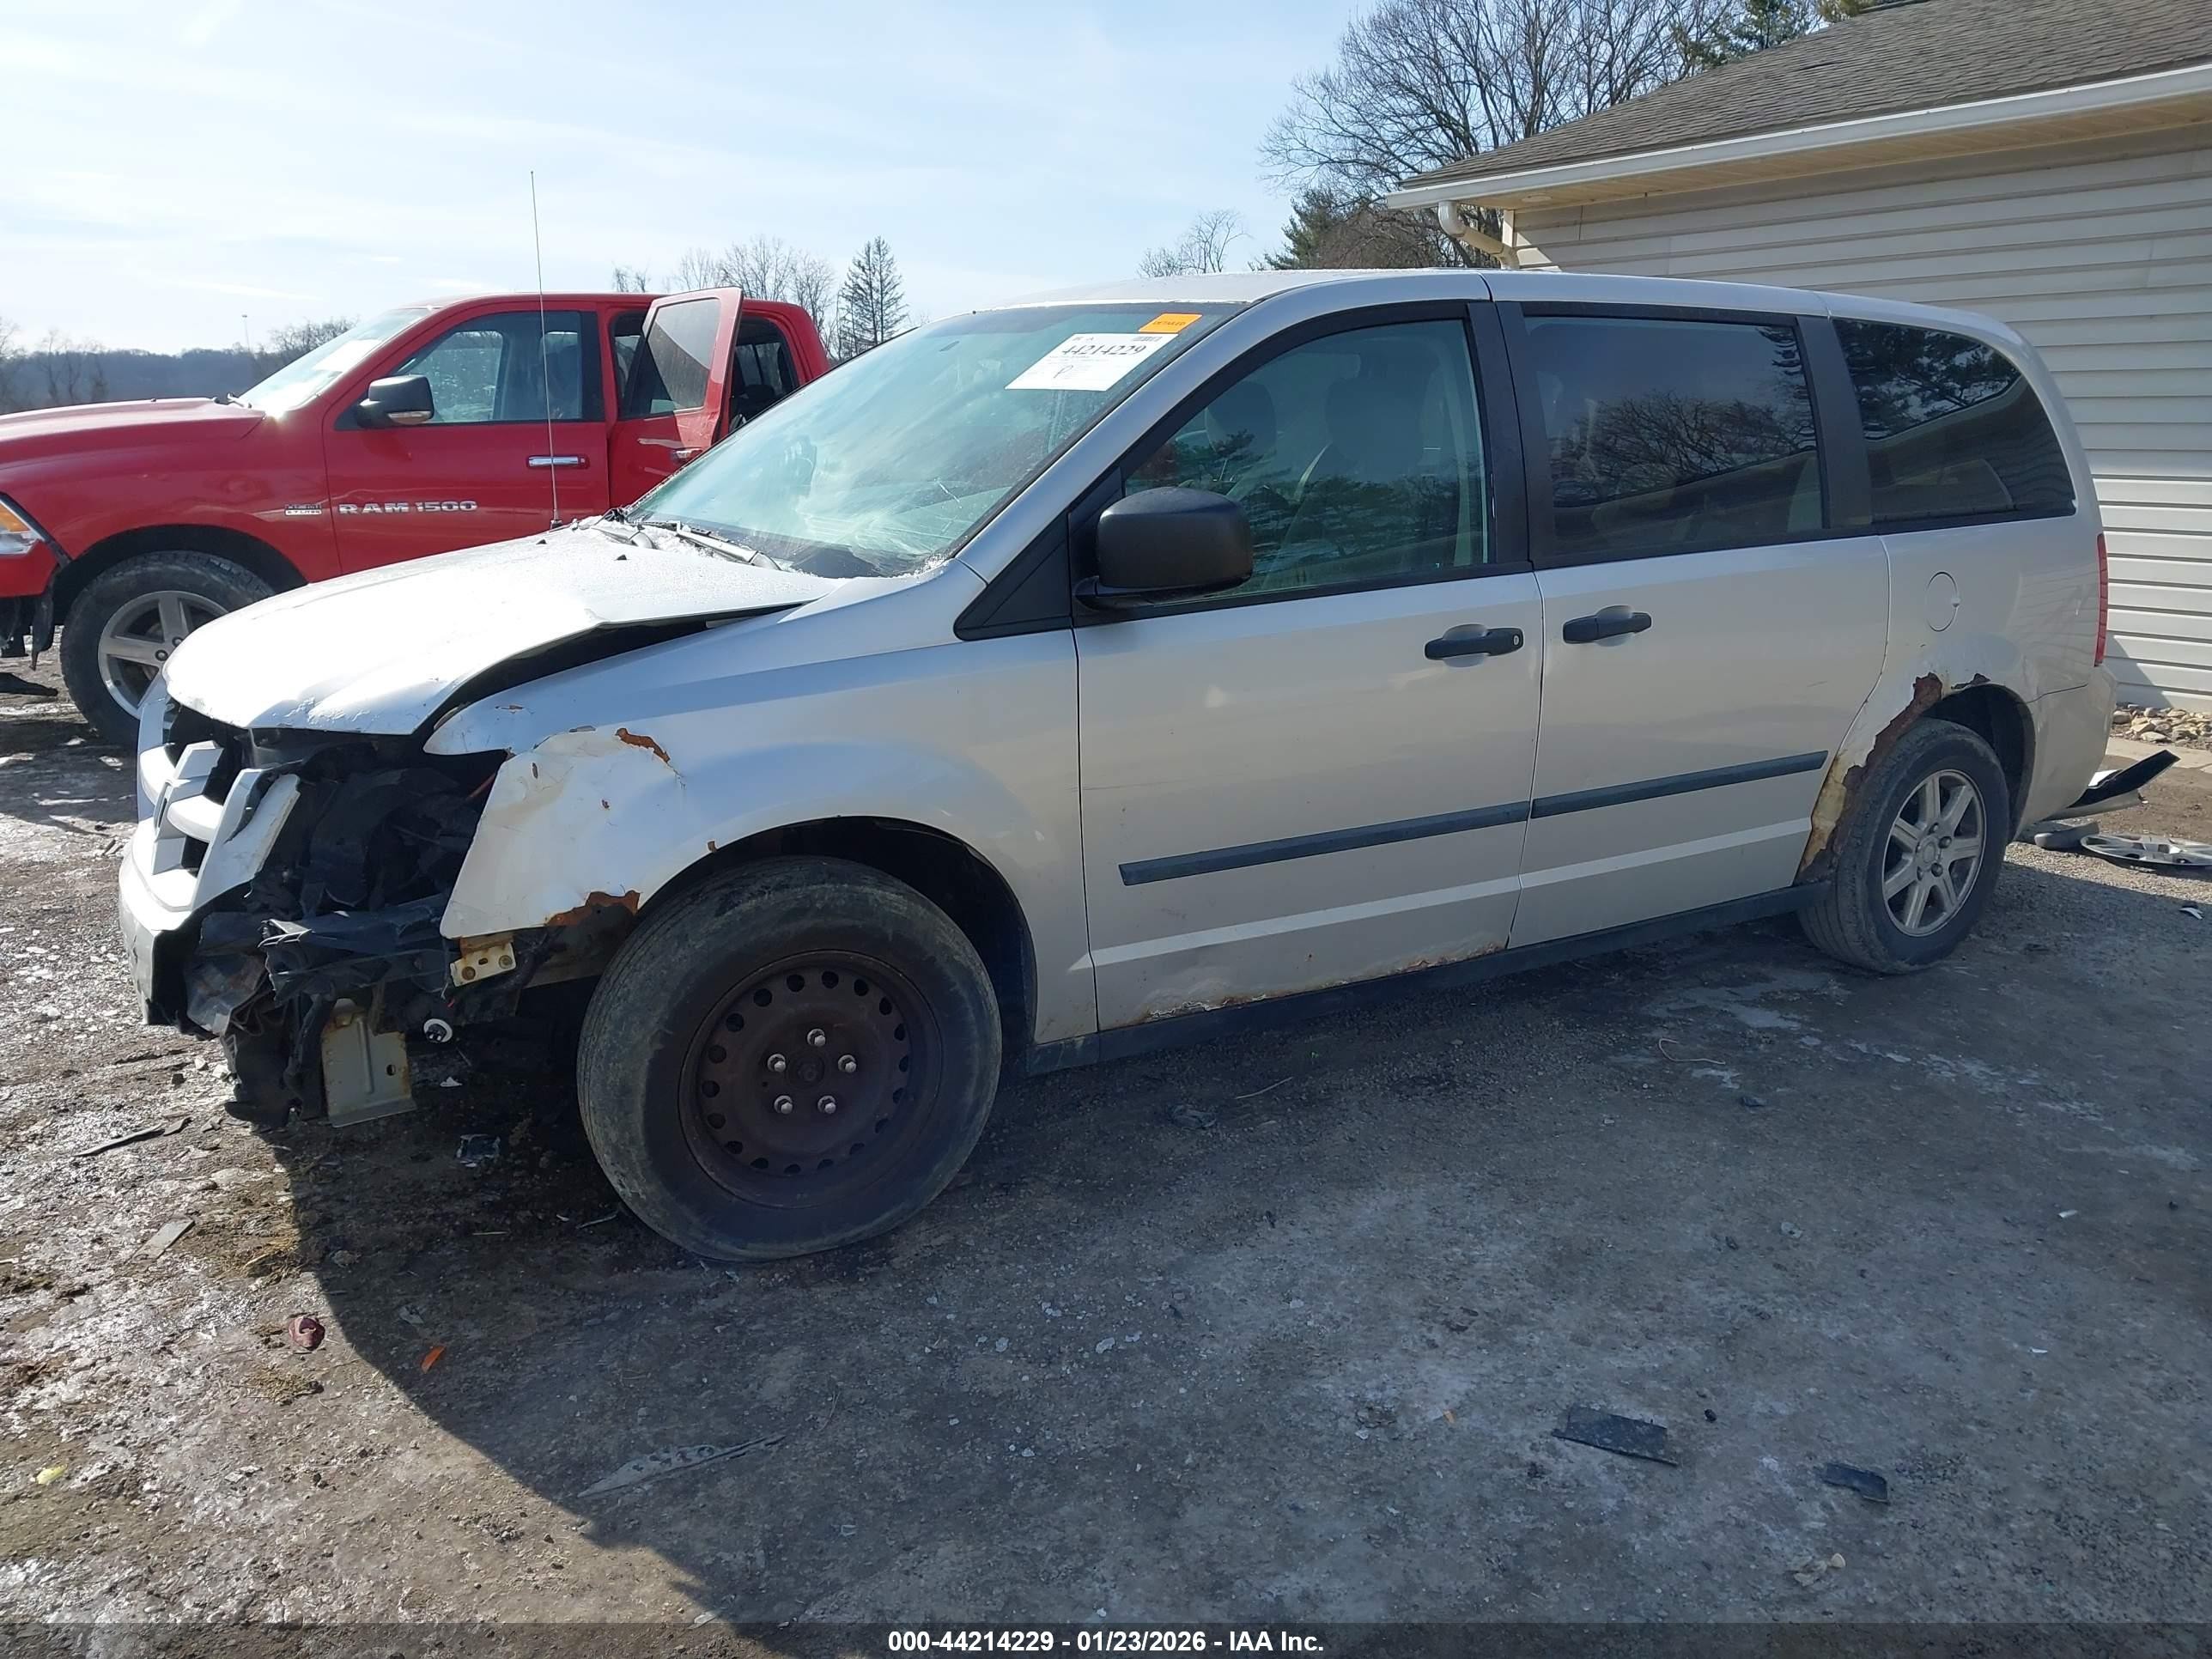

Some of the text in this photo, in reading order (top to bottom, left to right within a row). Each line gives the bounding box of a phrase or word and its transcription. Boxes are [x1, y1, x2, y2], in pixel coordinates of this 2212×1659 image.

[1061, 344, 1147, 356] 44214229
[338, 500, 478, 514] RAM 1500
